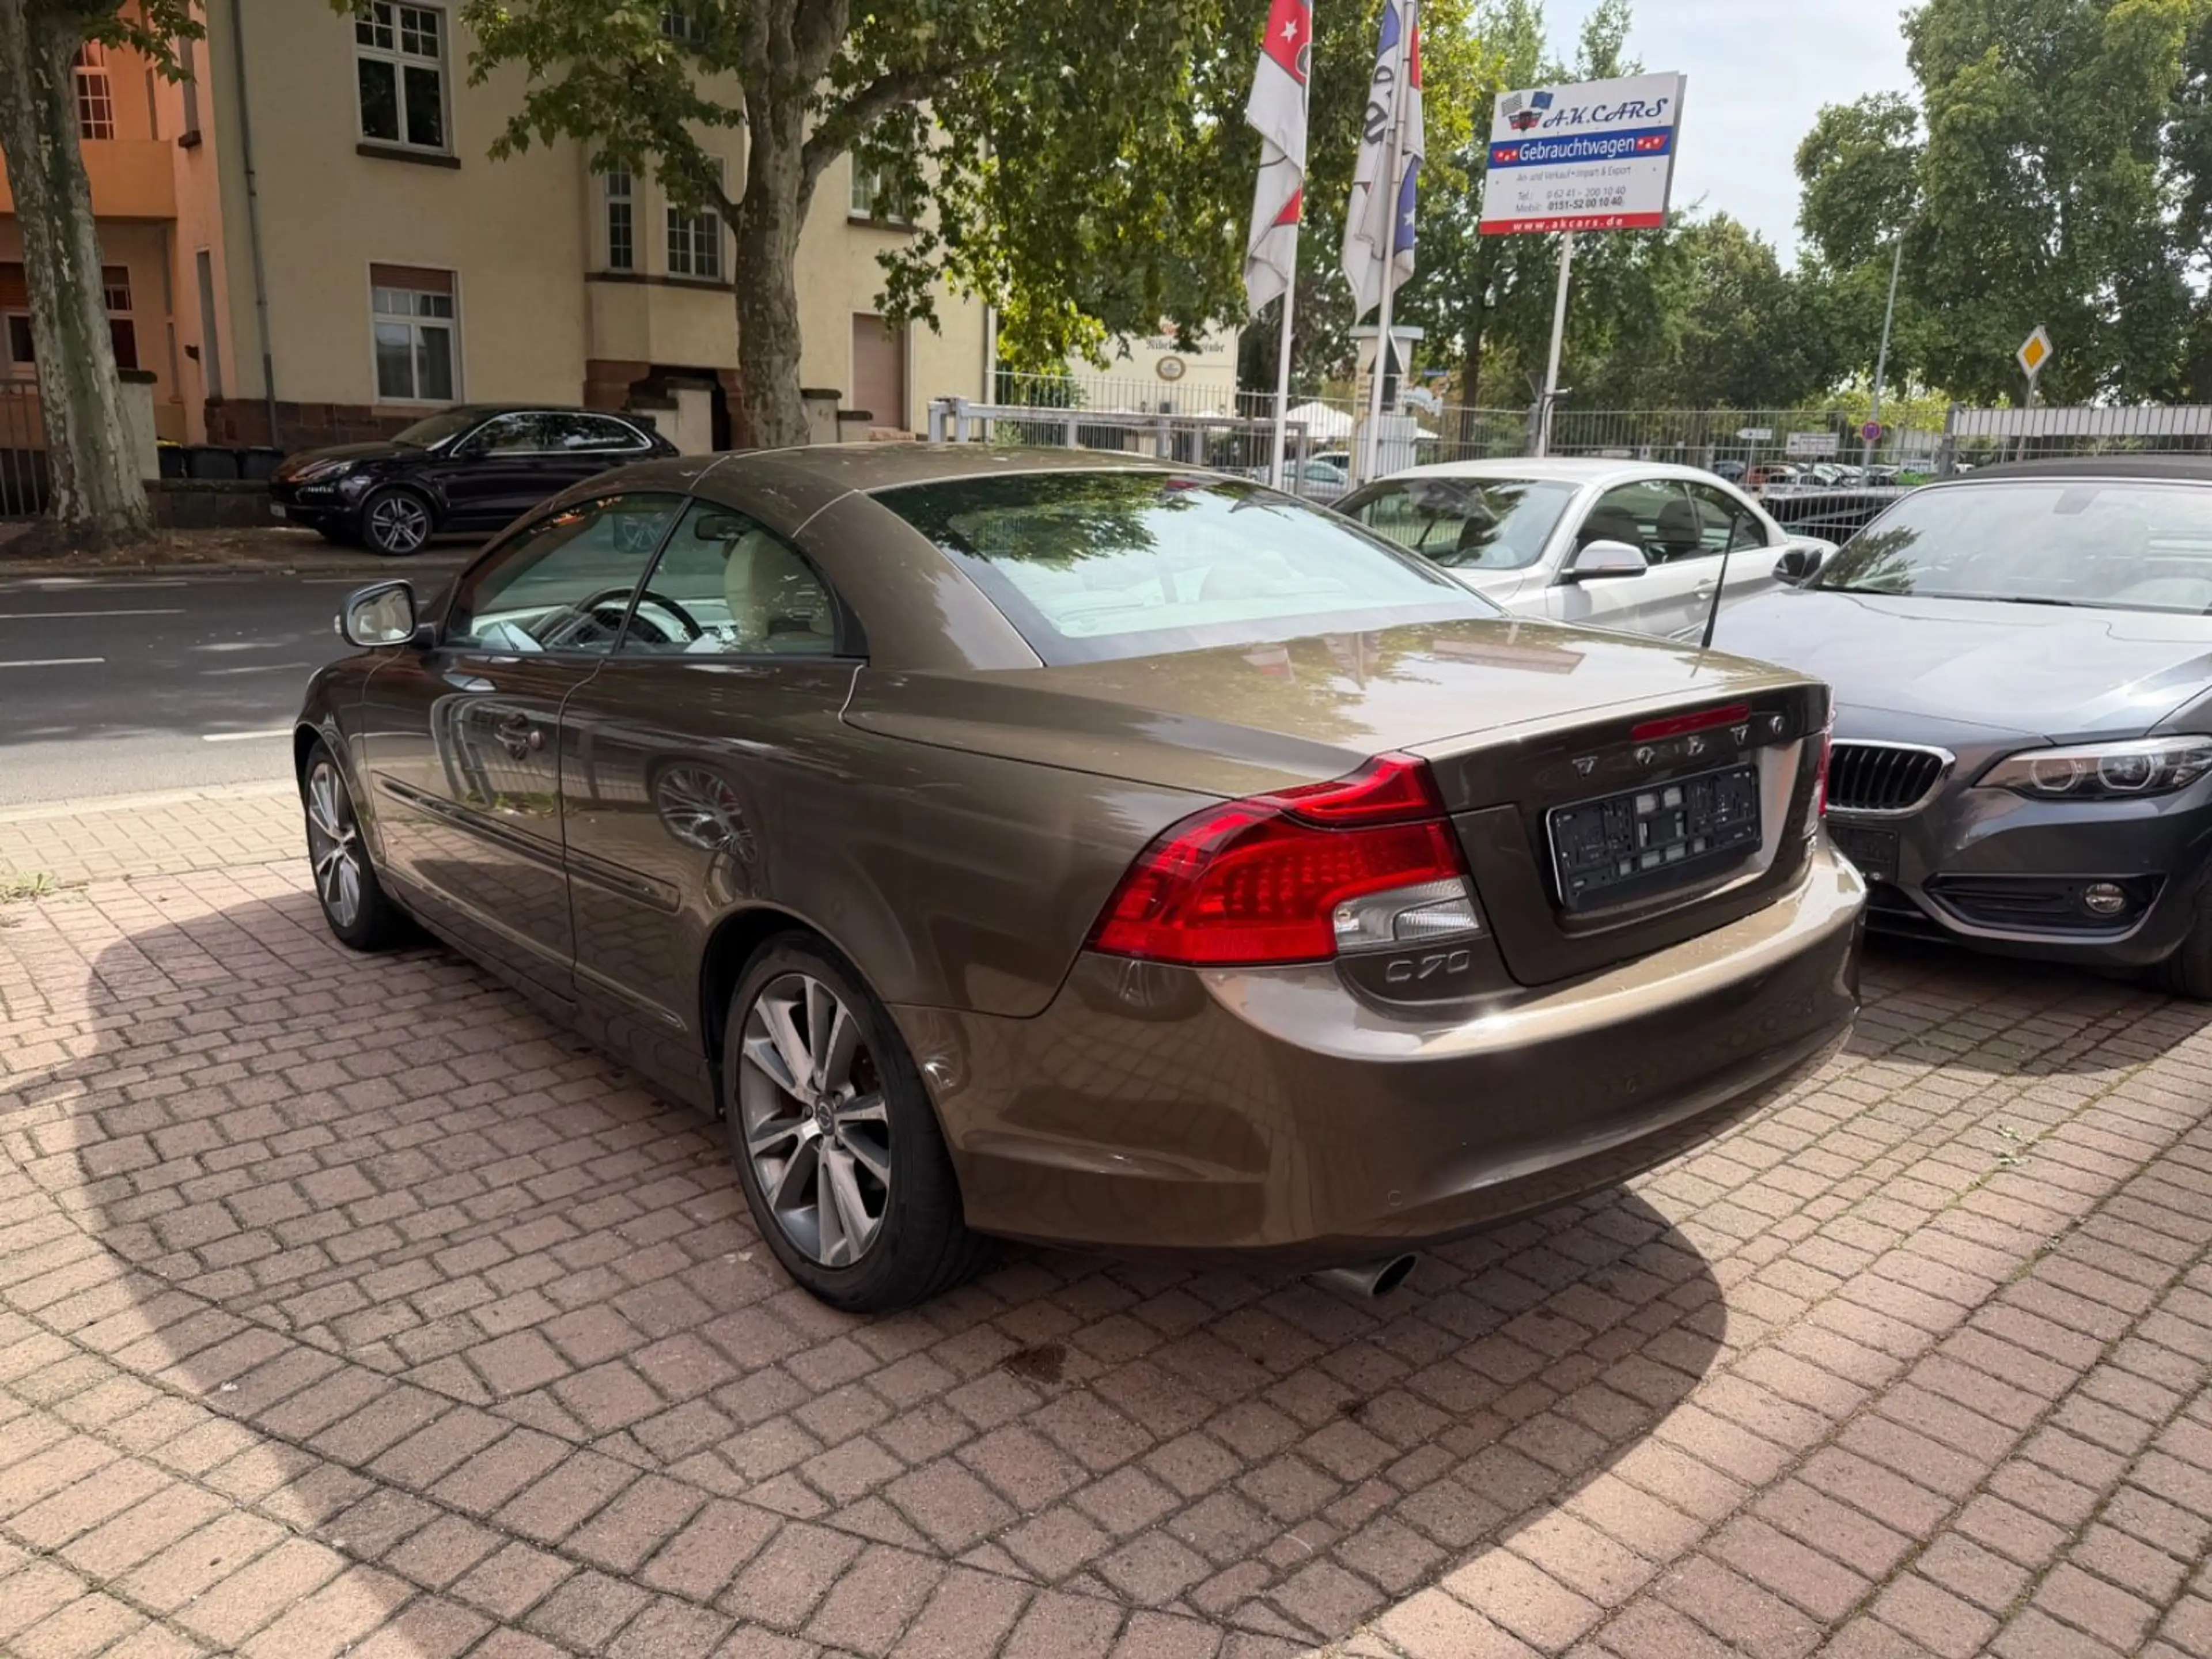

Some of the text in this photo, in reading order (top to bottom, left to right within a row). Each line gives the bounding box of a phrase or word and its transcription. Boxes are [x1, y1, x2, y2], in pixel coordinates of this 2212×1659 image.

[1519, 137, 1635, 160] Gebrauchtwagen
[1513, 216, 1623, 230] www.akcars.de
[1385, 949, 1471, 983] C70
